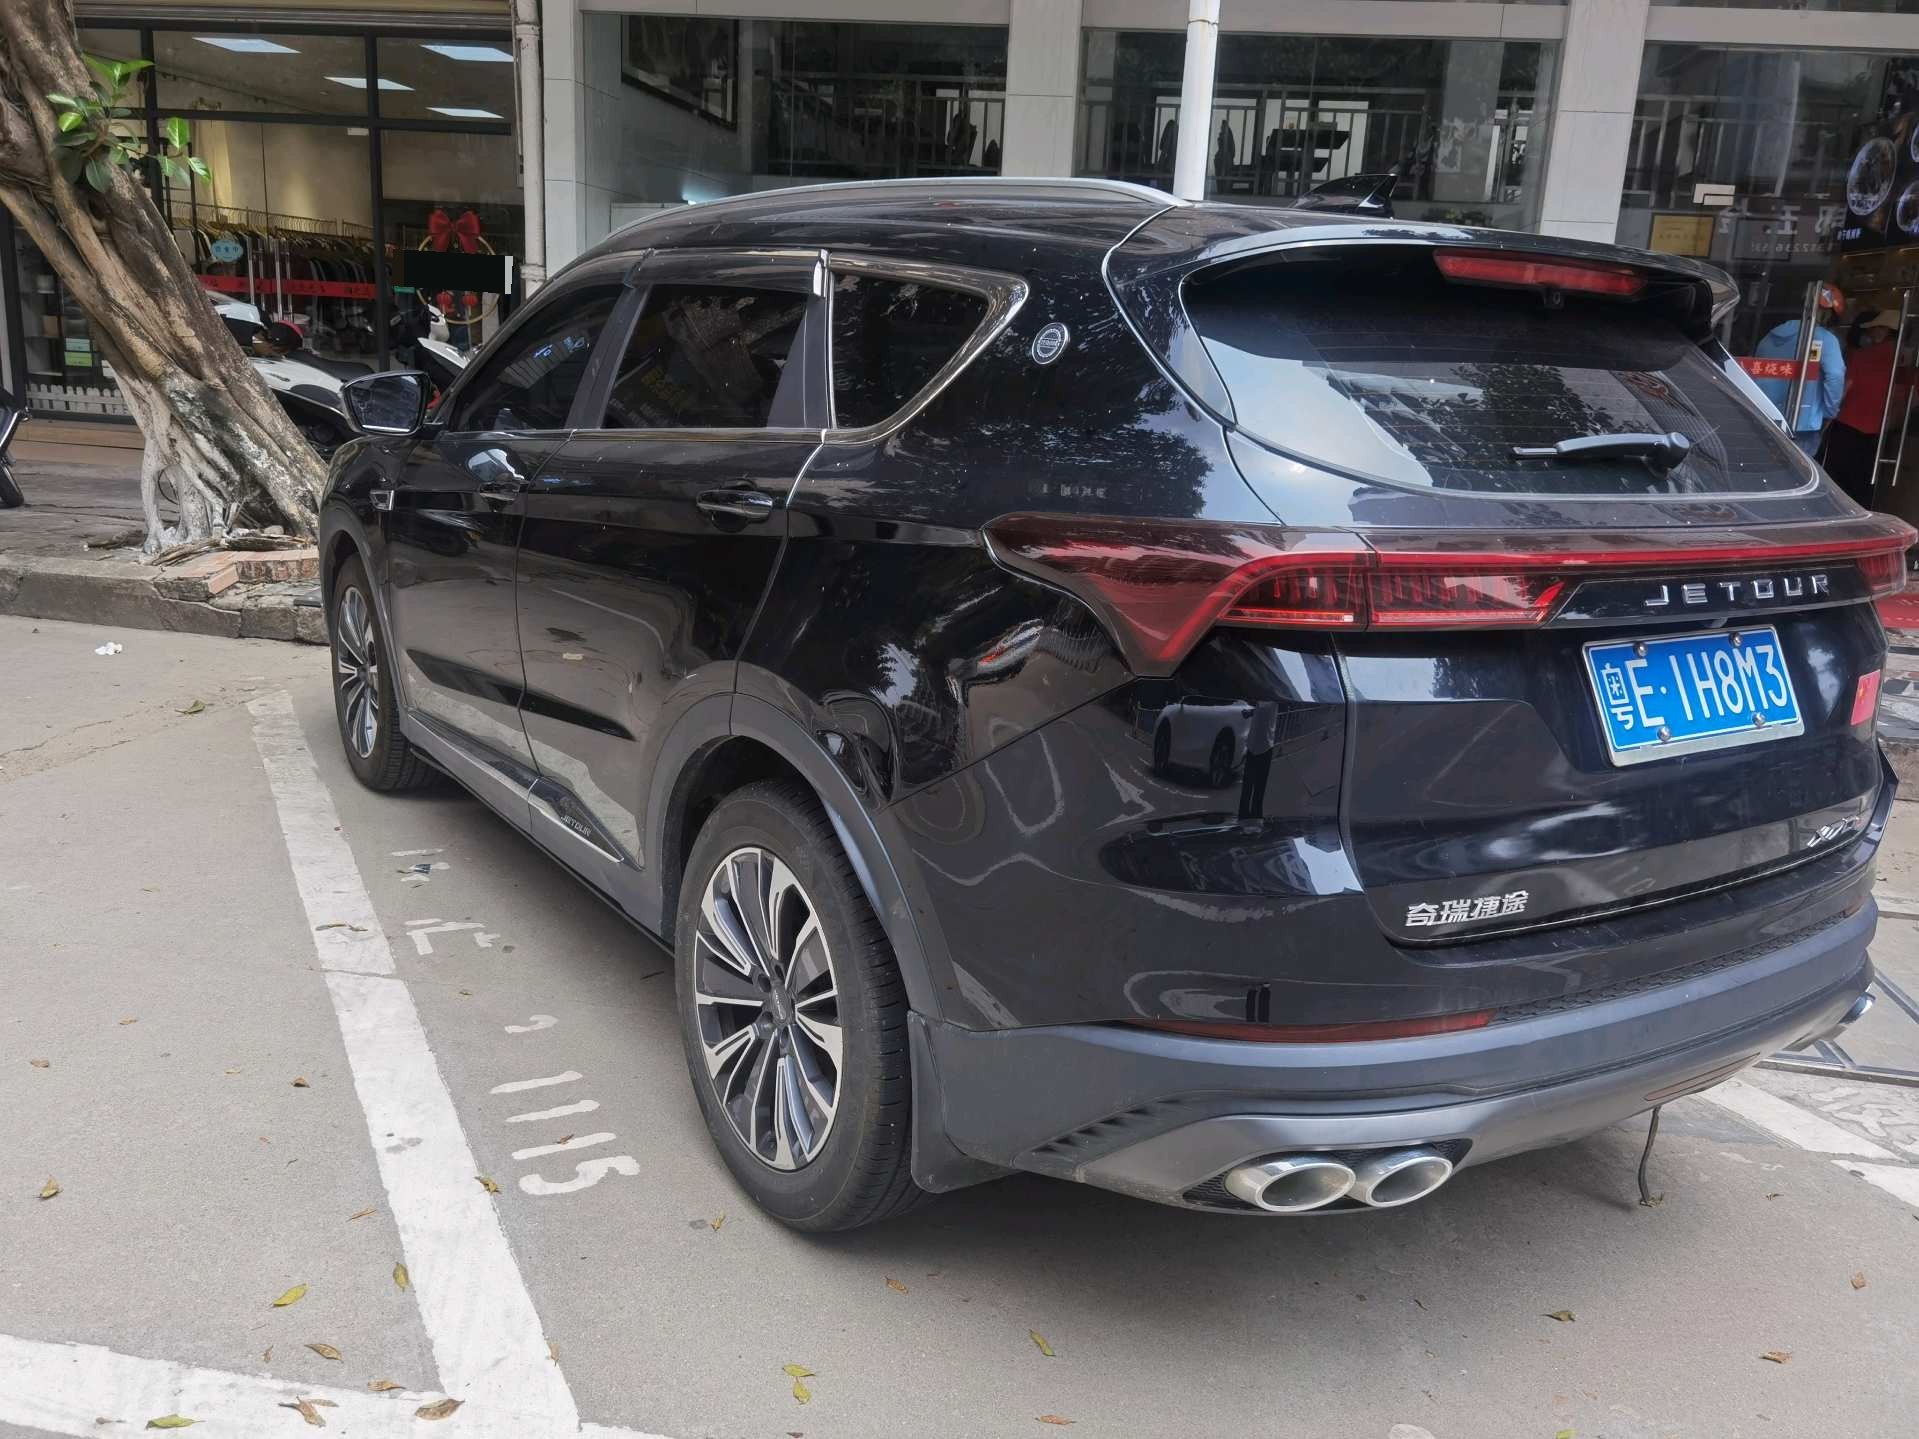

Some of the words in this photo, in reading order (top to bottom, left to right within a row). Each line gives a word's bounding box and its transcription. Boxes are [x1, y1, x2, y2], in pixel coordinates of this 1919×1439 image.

[1741, 361, 1793, 376] 喜烧味
[1643, 574, 1829, 606] JETOUR
[1601, 645, 1787, 730] 粤E·1H8M3
[1405, 890, 1529, 926] 奇瑞捷途
